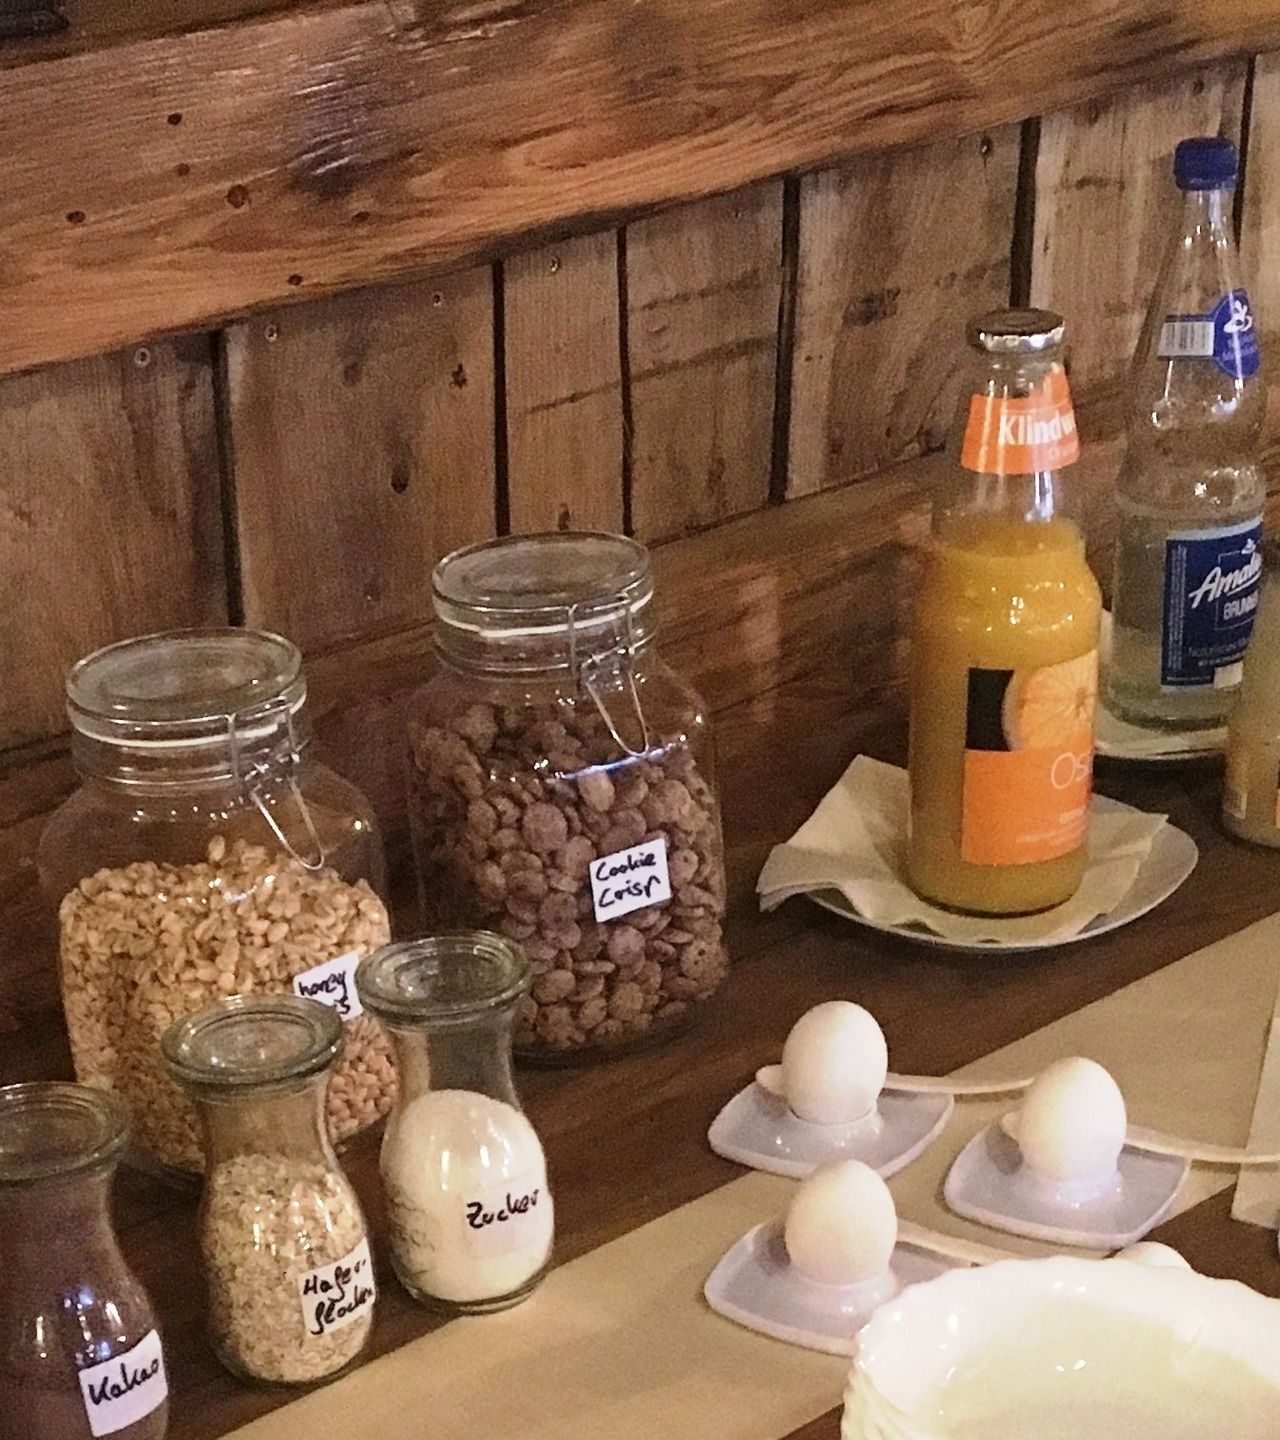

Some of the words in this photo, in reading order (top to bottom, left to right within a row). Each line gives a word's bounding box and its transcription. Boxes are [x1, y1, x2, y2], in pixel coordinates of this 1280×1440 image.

[596, 852, 656, 881] Cookie
[466, 1189, 540, 1229] Zucker
[88, 1358, 159, 1406] Kakao
